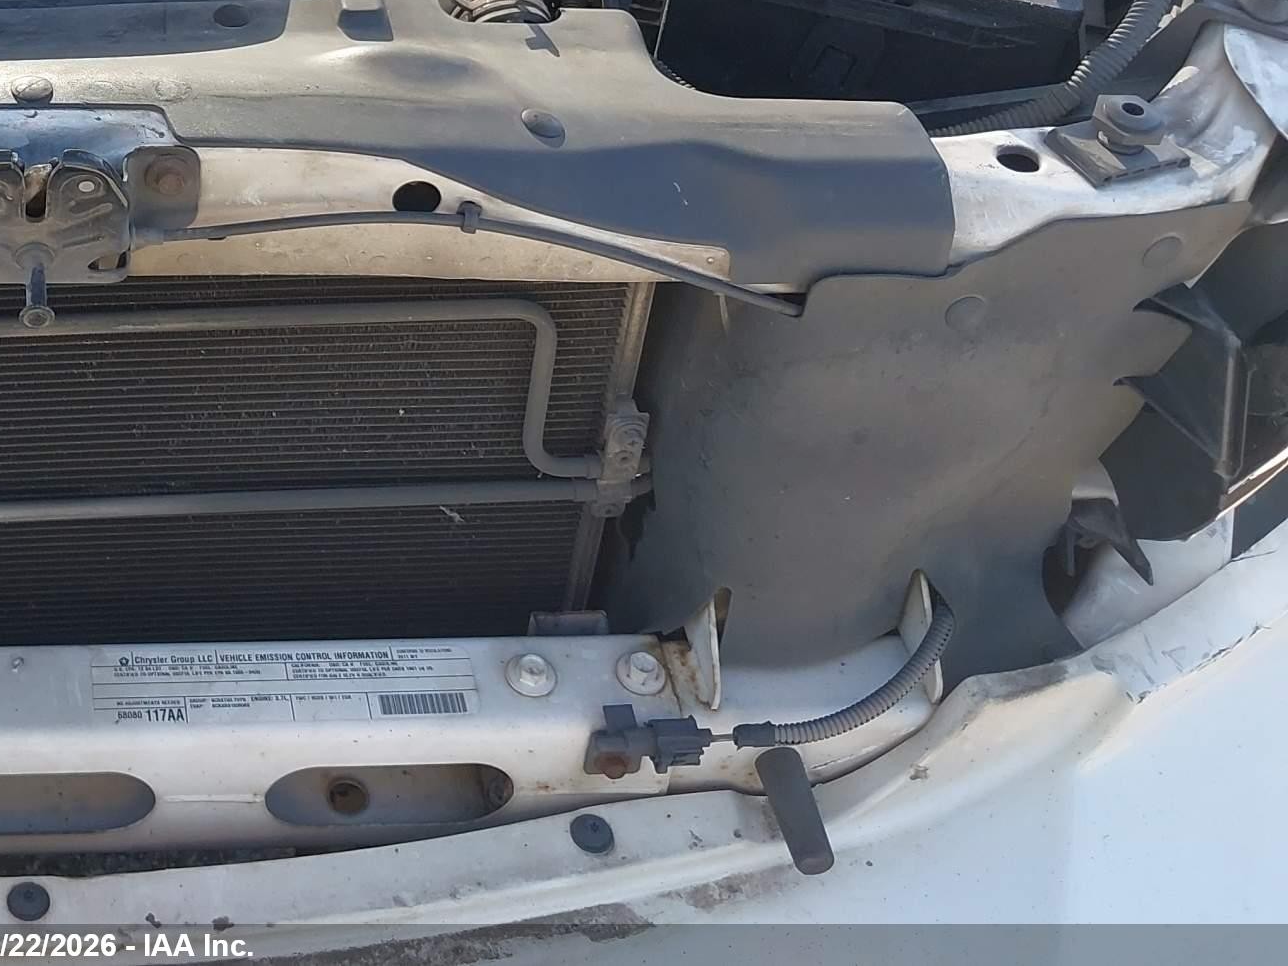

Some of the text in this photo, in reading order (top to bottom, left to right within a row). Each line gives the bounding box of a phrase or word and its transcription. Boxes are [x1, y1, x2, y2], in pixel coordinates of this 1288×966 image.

[135, 655, 168, 664] Chrysler
[171, 655, 195, 664] Group
[198, 654, 213, 662] LLC
[220, 653, 252, 662] VEHICLE
[255, 652, 293, 661] EMISSION
[296, 651, 332, 660] CONTROL
[334, 650, 389, 659] INFORMATION
[145, 708, 185, 722] 117AA
